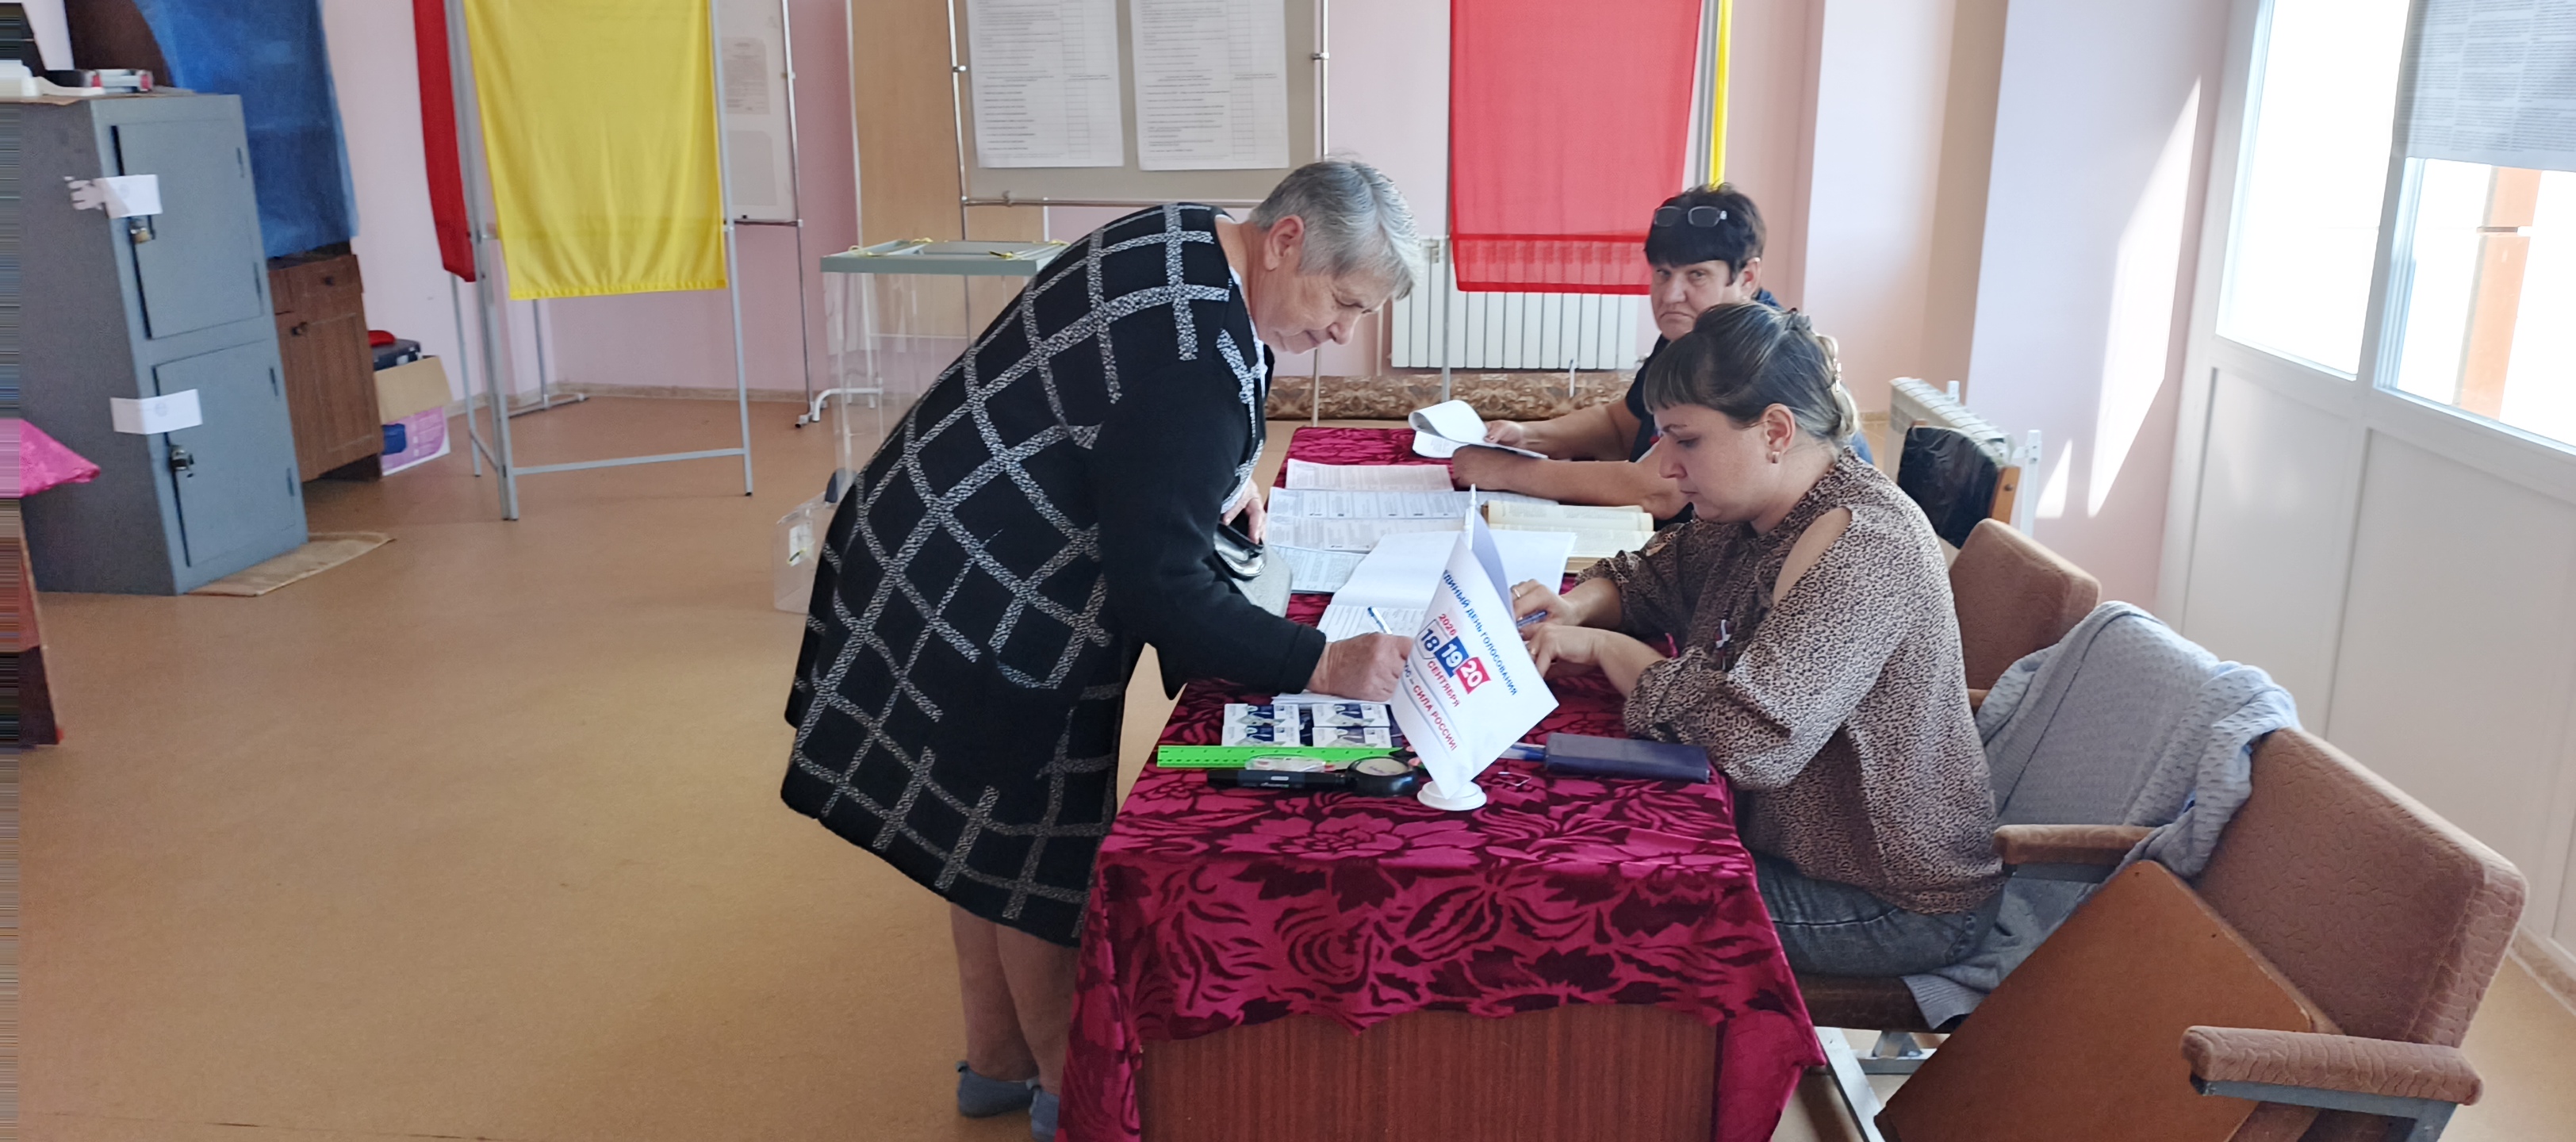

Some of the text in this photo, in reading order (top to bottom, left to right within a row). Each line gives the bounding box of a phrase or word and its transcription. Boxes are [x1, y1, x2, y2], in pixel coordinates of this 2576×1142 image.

[1420, 628, 1483, 688] 18 19 20
[1427, 660, 1460, 707] СЕНТЯБРЯ
[1466, 607, 1482, 633] ДЕНЬ
[1480, 631, 1518, 696] ГОЛОСОВАНИЯ
[1413, 684, 1433, 712] СИЛА
[1431, 710, 1458, 752] РОССИИ!
